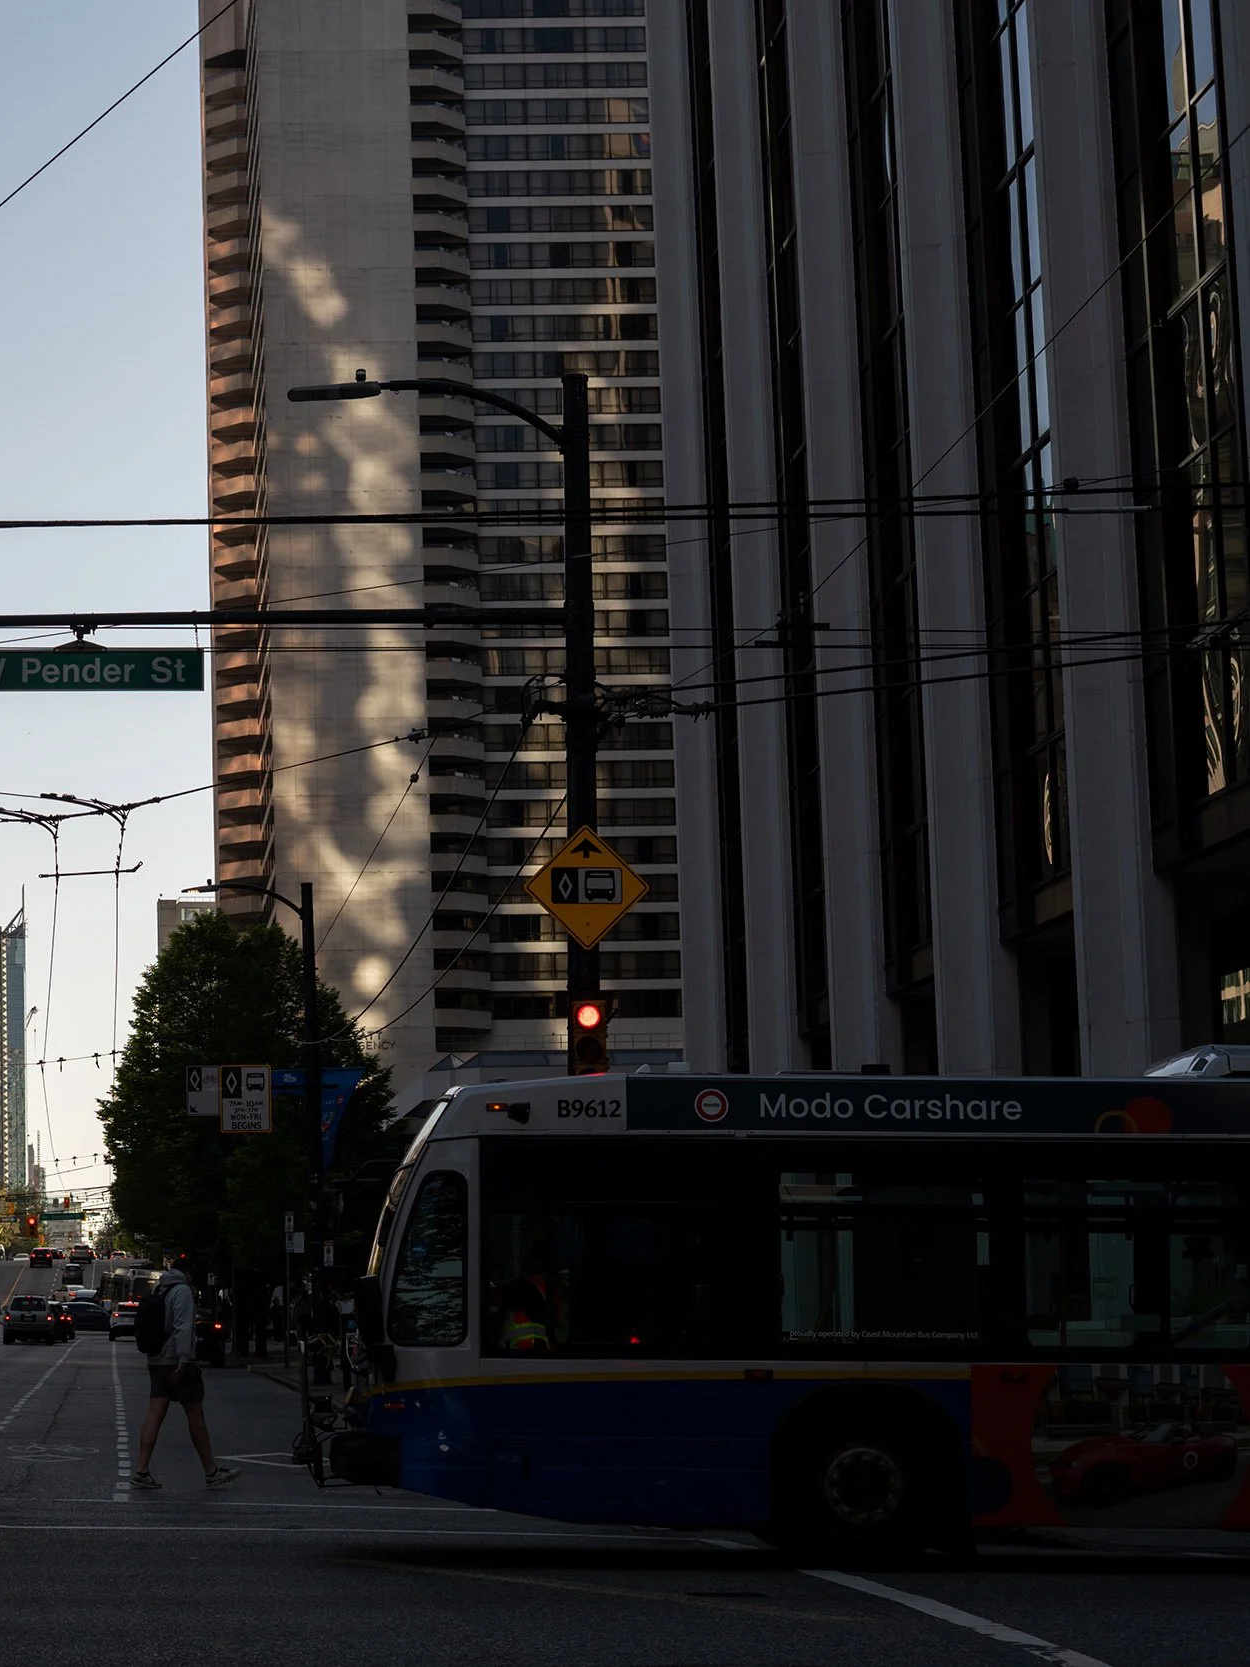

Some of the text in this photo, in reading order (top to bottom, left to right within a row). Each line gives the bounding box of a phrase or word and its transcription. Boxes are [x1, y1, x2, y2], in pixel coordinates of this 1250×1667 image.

[22, 657, 135, 684] Pender
[151, 657, 186, 683] St
[557, 1099, 622, 1119] B9612
[759, 1092, 1023, 1121] Modo Carshare
[230, 1113, 262, 1121] MON-FRI
[231, 1121, 262, 1130] BEGINS
[790, 1331, 817, 1339] proudly
[818, 1330, 849, 1339] operated
[851, 1331, 861, 1339] by
[861, 1330, 881, 1338] Coast
[882, 1330, 917, 1338] Mountain
[932, 1331, 965, 1340] Company
